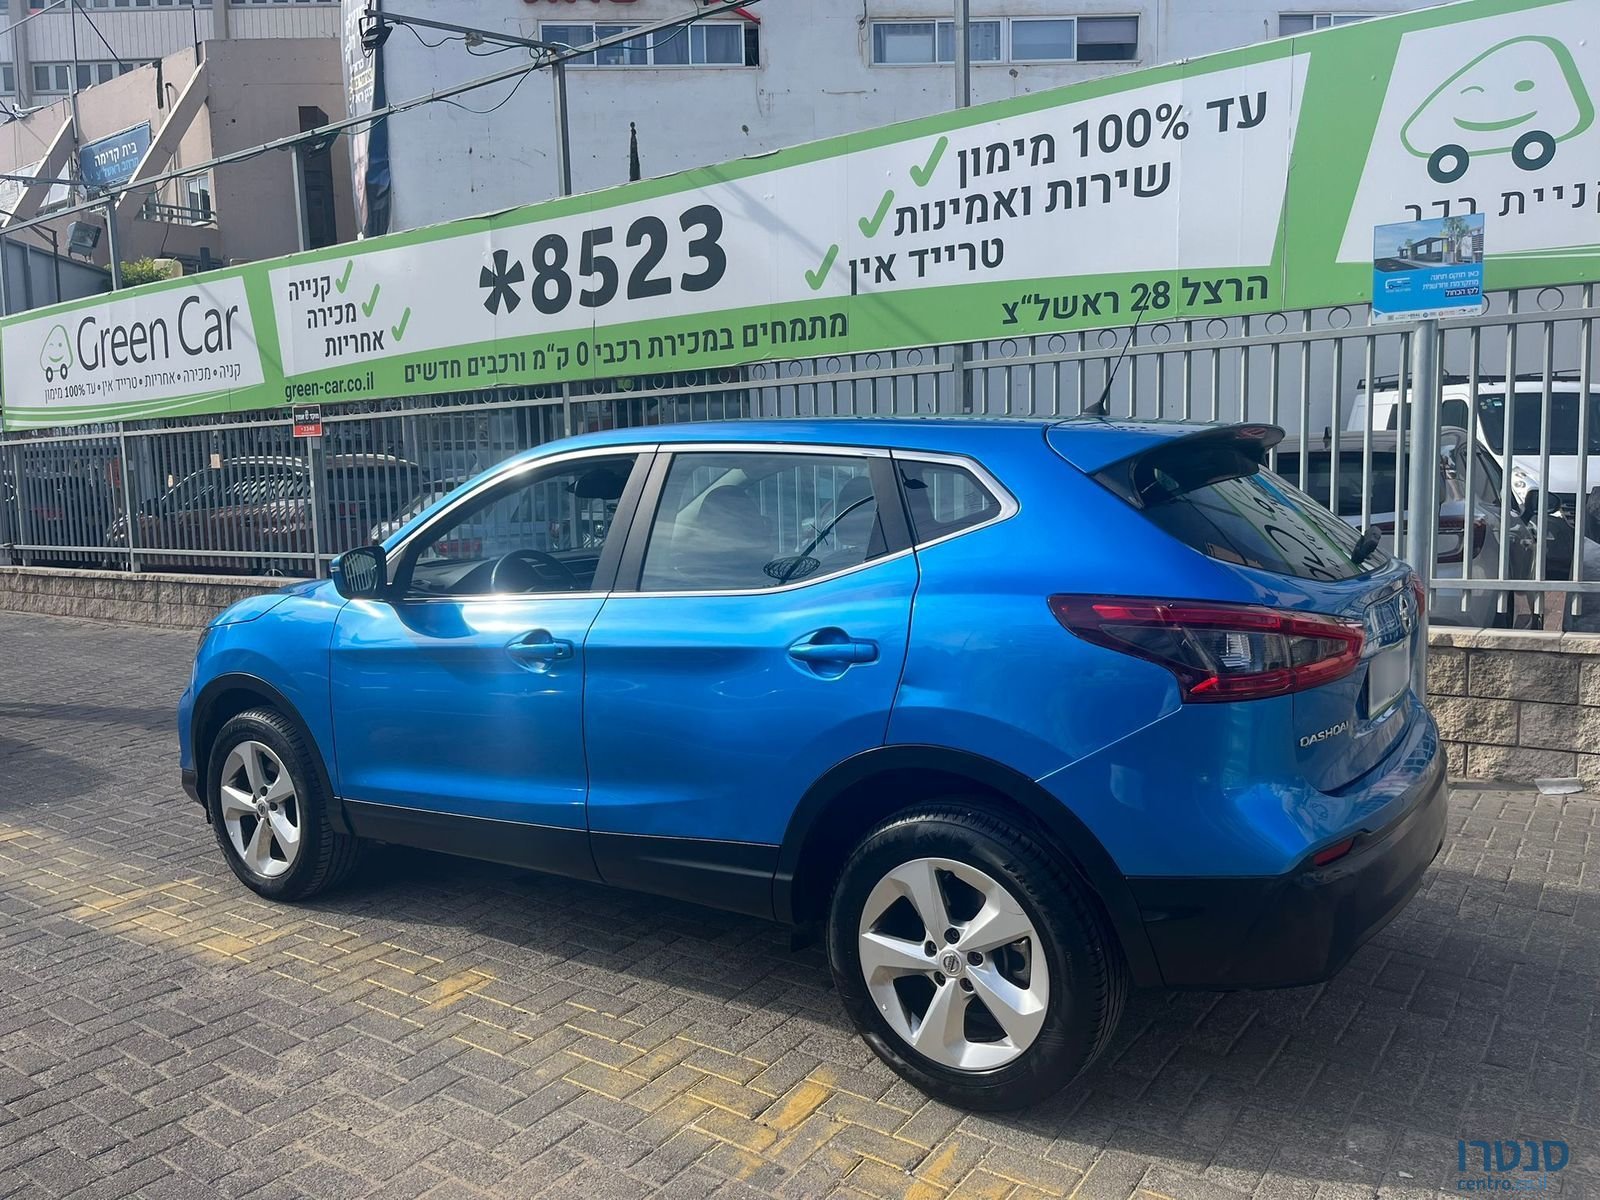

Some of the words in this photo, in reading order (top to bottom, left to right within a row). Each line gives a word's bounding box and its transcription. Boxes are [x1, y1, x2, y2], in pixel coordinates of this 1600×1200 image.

[1206, 91, 1268, 133] עד
[1072, 102, 1189, 158] 100%
[95, 148, 119, 167] קדימה
[122, 142, 137, 157] בית
[957, 132, 1056, 189] מימון
[1045, 162, 1172, 213] שירות
[1499, 181, 1600, 217] ניית
[894, 184, 1031, 237] ואמינות
[908, 238, 1004, 278] טרייד
[848, 253, 897, 296] אין
[288, 276, 330, 302] קנייה
[1130, 280, 1170, 312] 28
[1182, 274, 1268, 308] הרצל
[307, 302, 357, 329] מכירה
[1002, 290, 1120, 325] ראשל"צ
[77, 316, 169, 371] Green
[178, 296, 238, 356] Car
[648, 327, 734, 359] במכירת
[743, 312, 847, 348] מתמחים
[325, 330, 384, 358] אחריות
[576, 341, 589, 366] 0
[595, 339, 640, 364] רכבי
[183, 367, 211, 383] מכירה
[220, 364, 241, 379] קניה
[404, 359, 461, 383] חדשים
[468, 351, 526, 376] ורכבים
[64, 384, 86, 398] 100%
[86, 383, 96, 395] עד
[102, 380, 114, 396] אין
[116, 376, 138, 390] טרייד
[144, 372, 176, 388] אחריות
[285, 371, 374, 402] green-car.co.il
[44, 387, 62, 404] מימון
